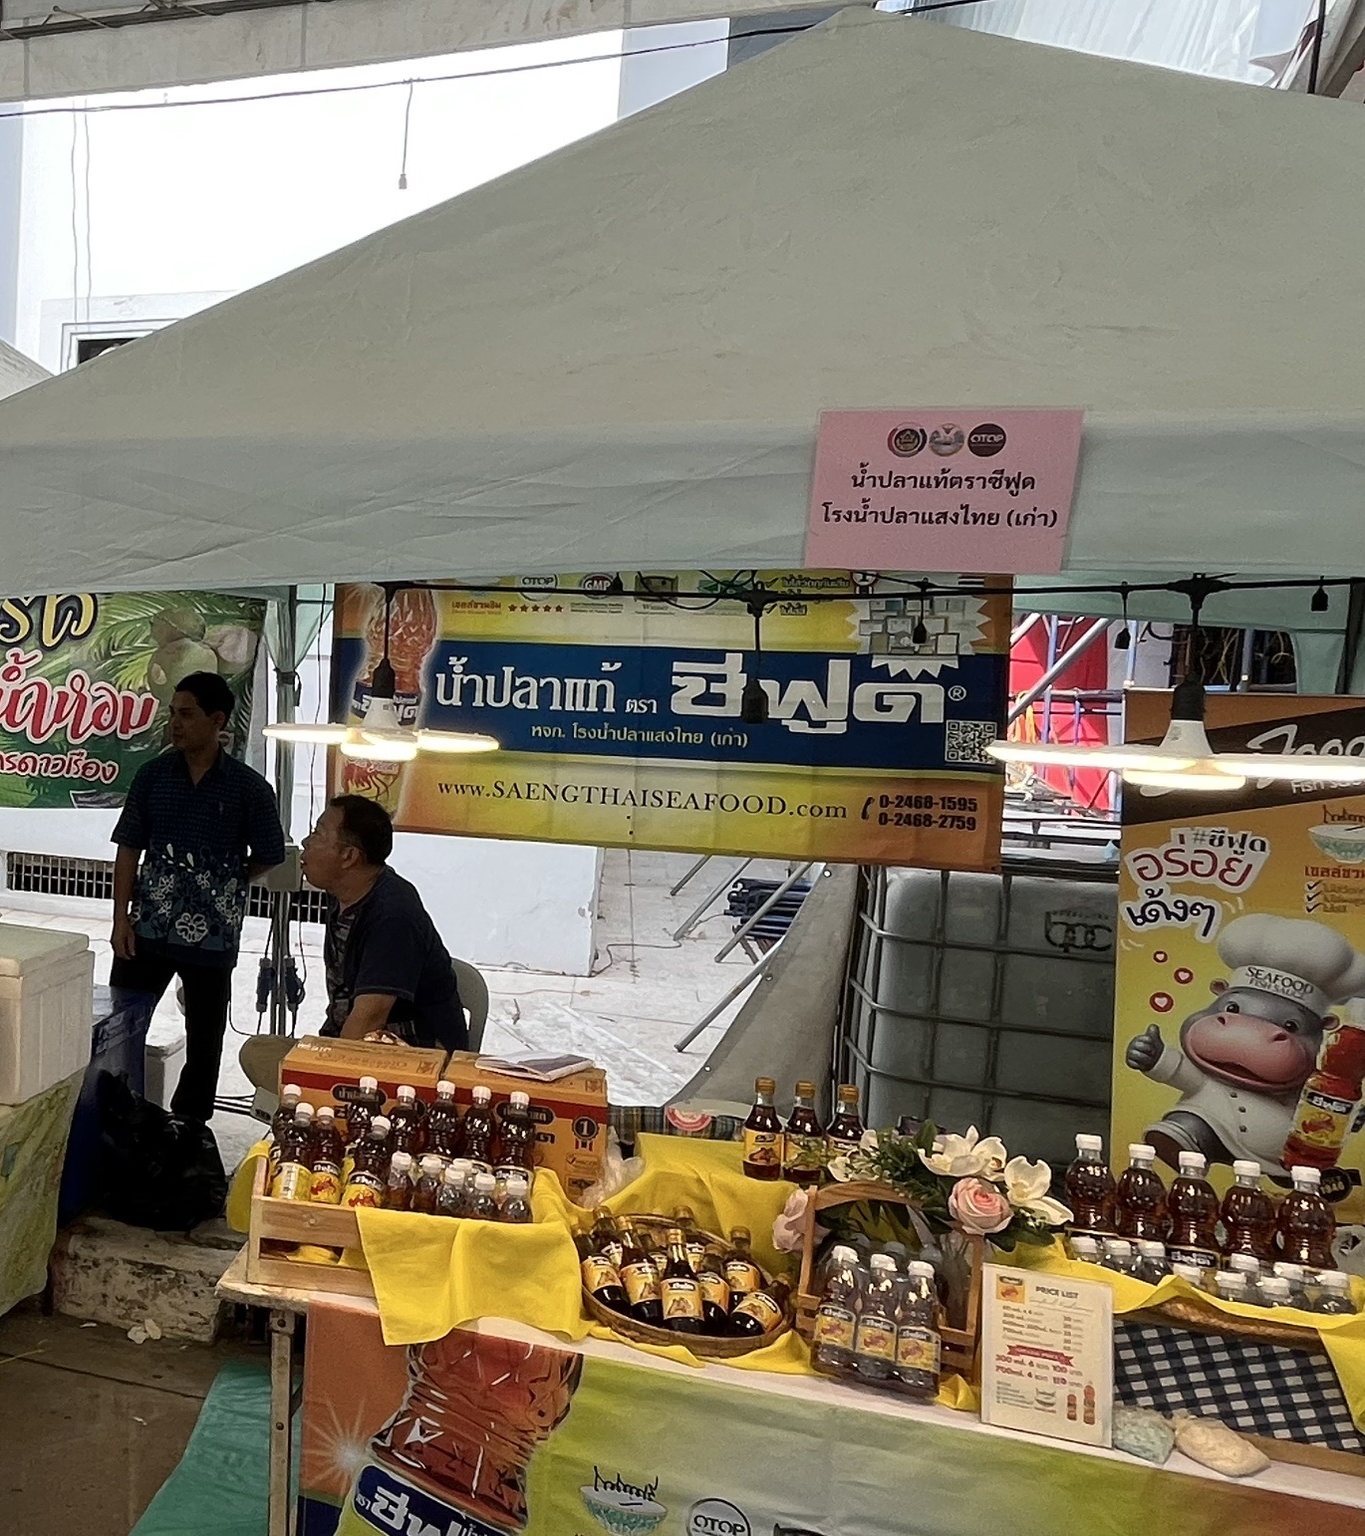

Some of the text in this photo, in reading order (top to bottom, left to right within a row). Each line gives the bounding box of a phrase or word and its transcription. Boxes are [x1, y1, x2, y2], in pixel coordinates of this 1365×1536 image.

[851, 463, 1036, 496] น้ำปลาแท้ตราซีฟูด
[821, 498, 1058, 528] โรงน้ำปลาแสงไทย (เก่า)
[585, 579, 611, 592] GMP
[435, 656, 622, 713] น้ำปลาแท้
[624, 698, 658, 714] ตรา
[571, 721, 704, 744] โรงน้ำปลาแสงไทย
[437, 779, 848, 819] www.SAENGTHAISEAFOOD.com
[878, 794, 978, 812] 0-2468-1595
[878, 812, 977, 831] 0-2468-2759
[1132, 834, 1253, 887] อร่อย
[1126, 888, 1216, 937] เด้งๆ
[1245, 966, 1314, 994] SEAFOOD
[579, 1120, 590, 1136] 1
[1035, 1286, 1060, 1297] PRICE
[693, 1514, 746, 1534] OTOP
